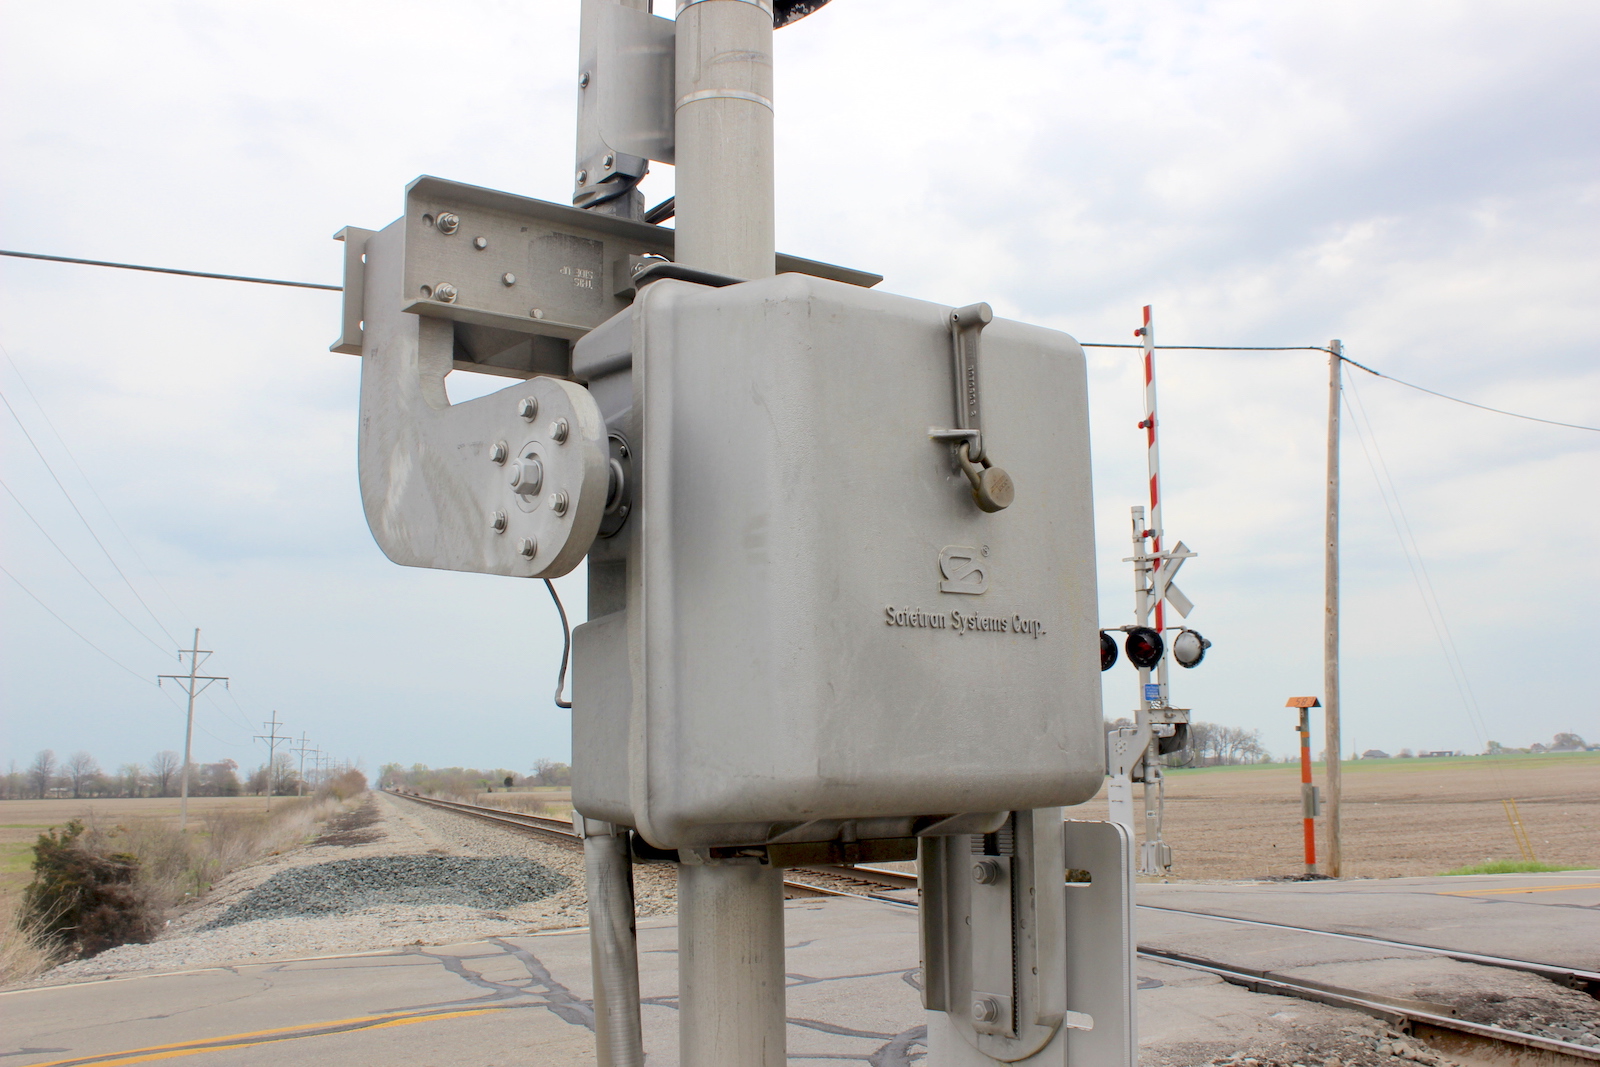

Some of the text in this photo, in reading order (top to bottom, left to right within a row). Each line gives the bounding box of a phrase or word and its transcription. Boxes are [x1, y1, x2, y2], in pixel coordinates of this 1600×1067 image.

[559, 266, 593, 279] SIDE UP
[885, 605, 1047, 639] Safetran Systems Corp.
